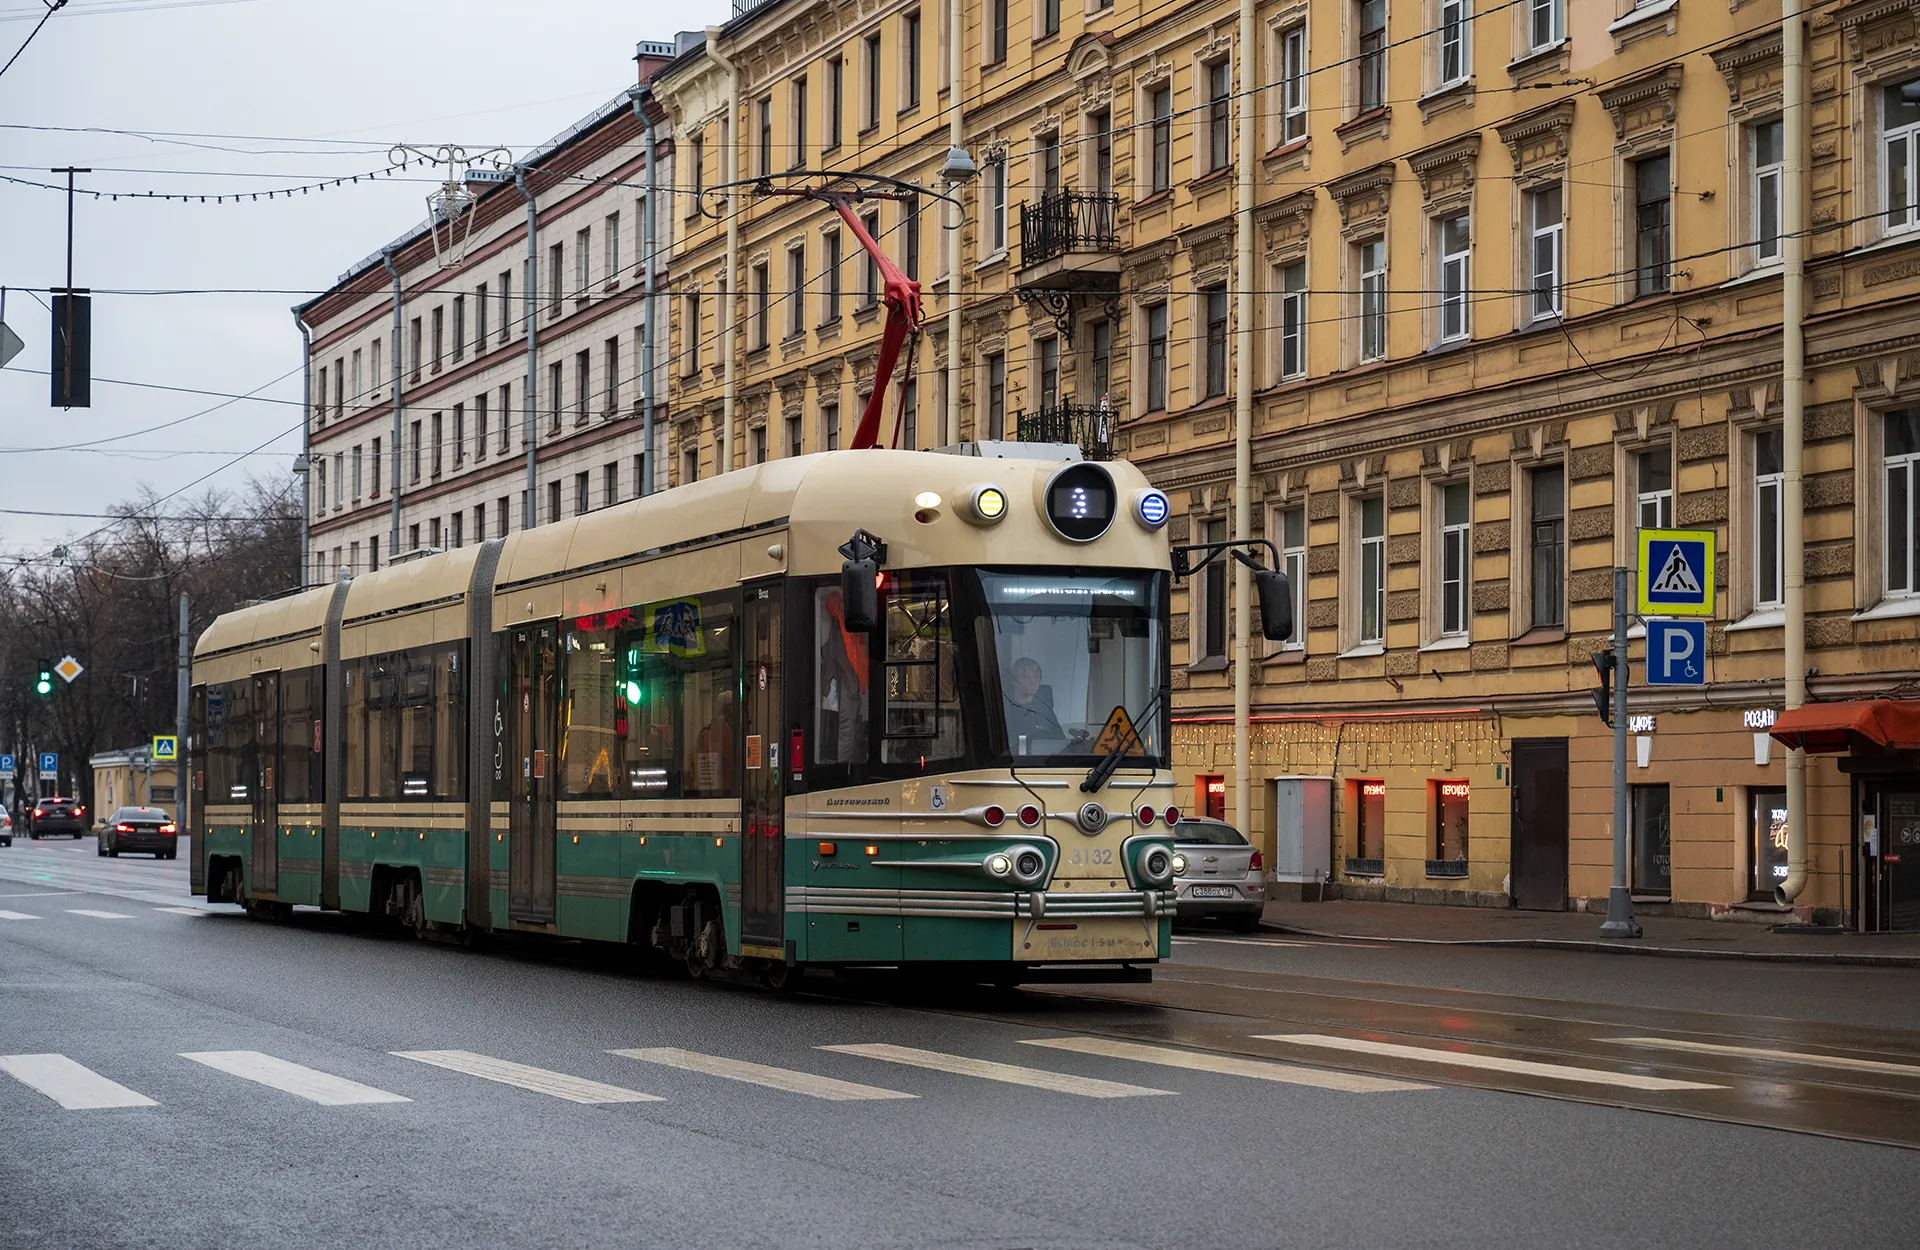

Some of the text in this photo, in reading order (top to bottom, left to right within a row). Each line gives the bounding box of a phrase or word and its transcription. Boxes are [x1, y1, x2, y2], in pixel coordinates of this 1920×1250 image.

[1664, 628, 1695, 678] P
[1629, 715, 1653, 733] КАФЕ
[45, 755, 55, 769] P
[1071, 849, 1113, 865] 3132
